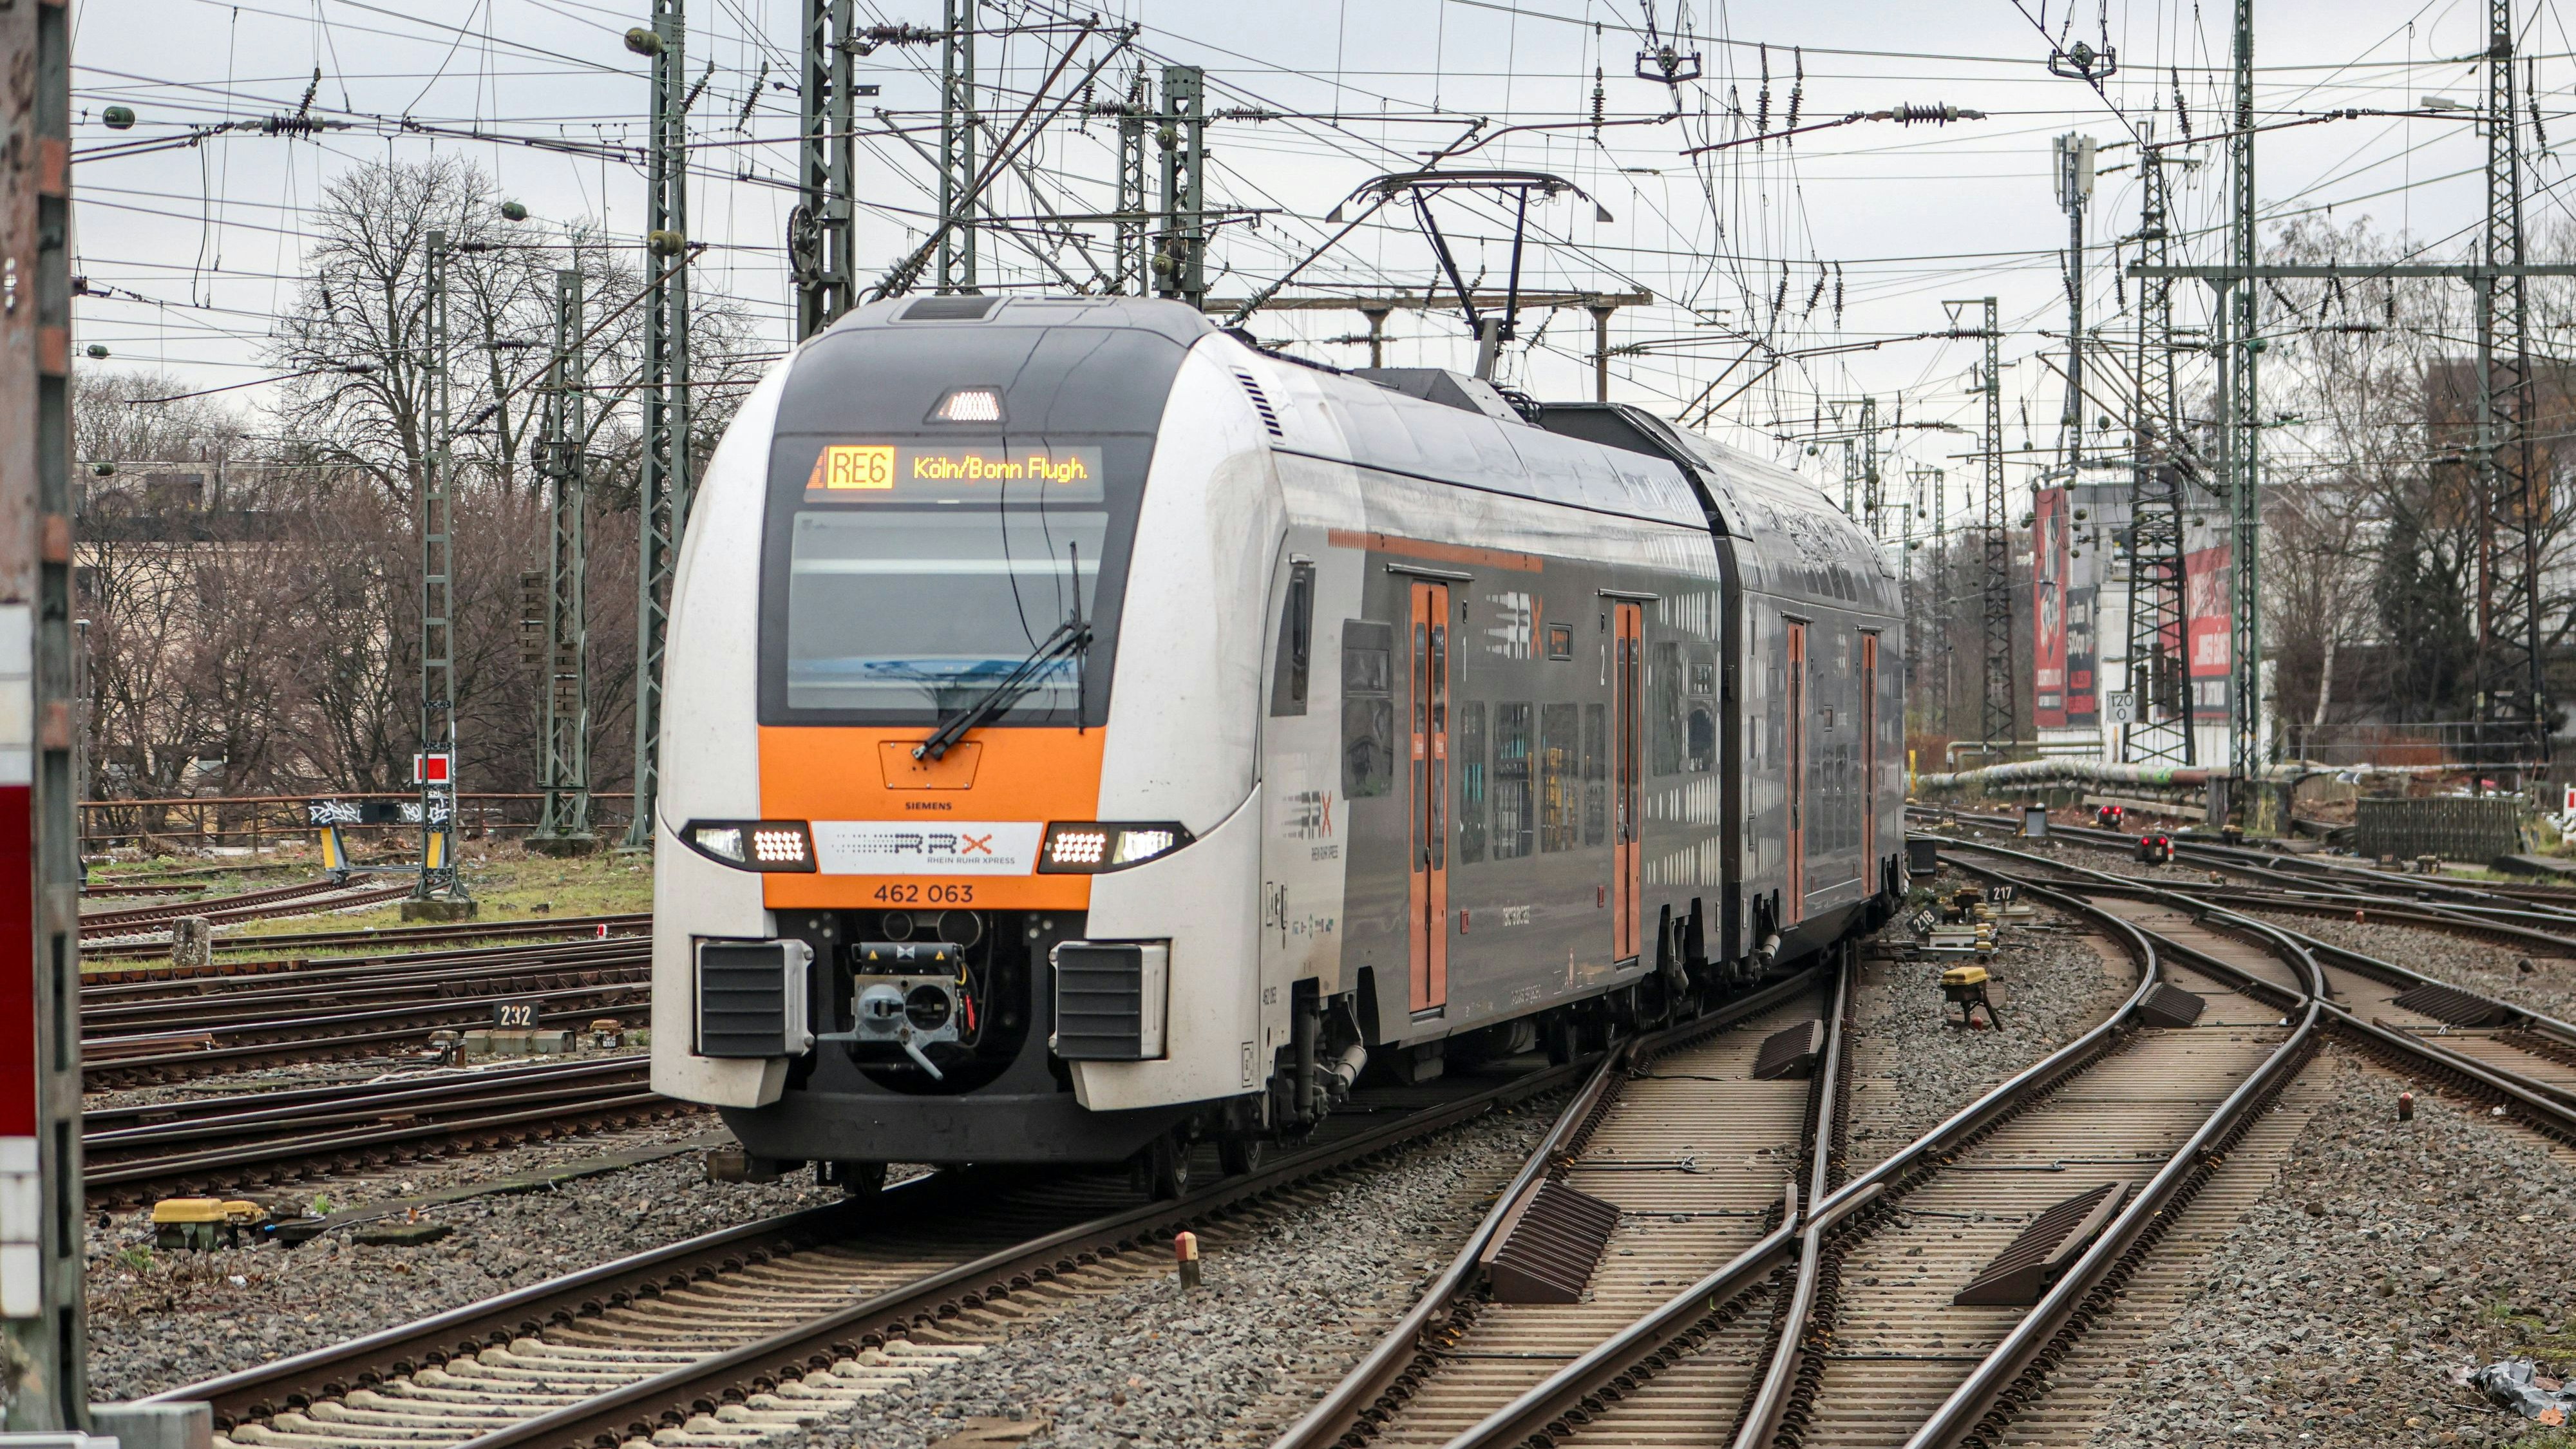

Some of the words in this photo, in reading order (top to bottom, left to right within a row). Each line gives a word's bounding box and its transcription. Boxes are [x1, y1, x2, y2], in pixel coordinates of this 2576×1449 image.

[833, 453, 887, 483] RE6
[913, 455, 1022, 479] Köln/Bonn
[1028, 457, 1088, 483] Flugh.
[2112, 695, 2133, 706] 120
[2117, 708, 2126, 720] 0
[905, 802, 952, 810] SIEMENS
[893, 834, 993, 854] RRX
[875, 884, 919, 903] 462
[927, 884, 974, 903] 063
[1993, 886, 2012, 900] 217
[1913, 909, 1935, 933] 218
[500, 1005, 531, 1027] 232
